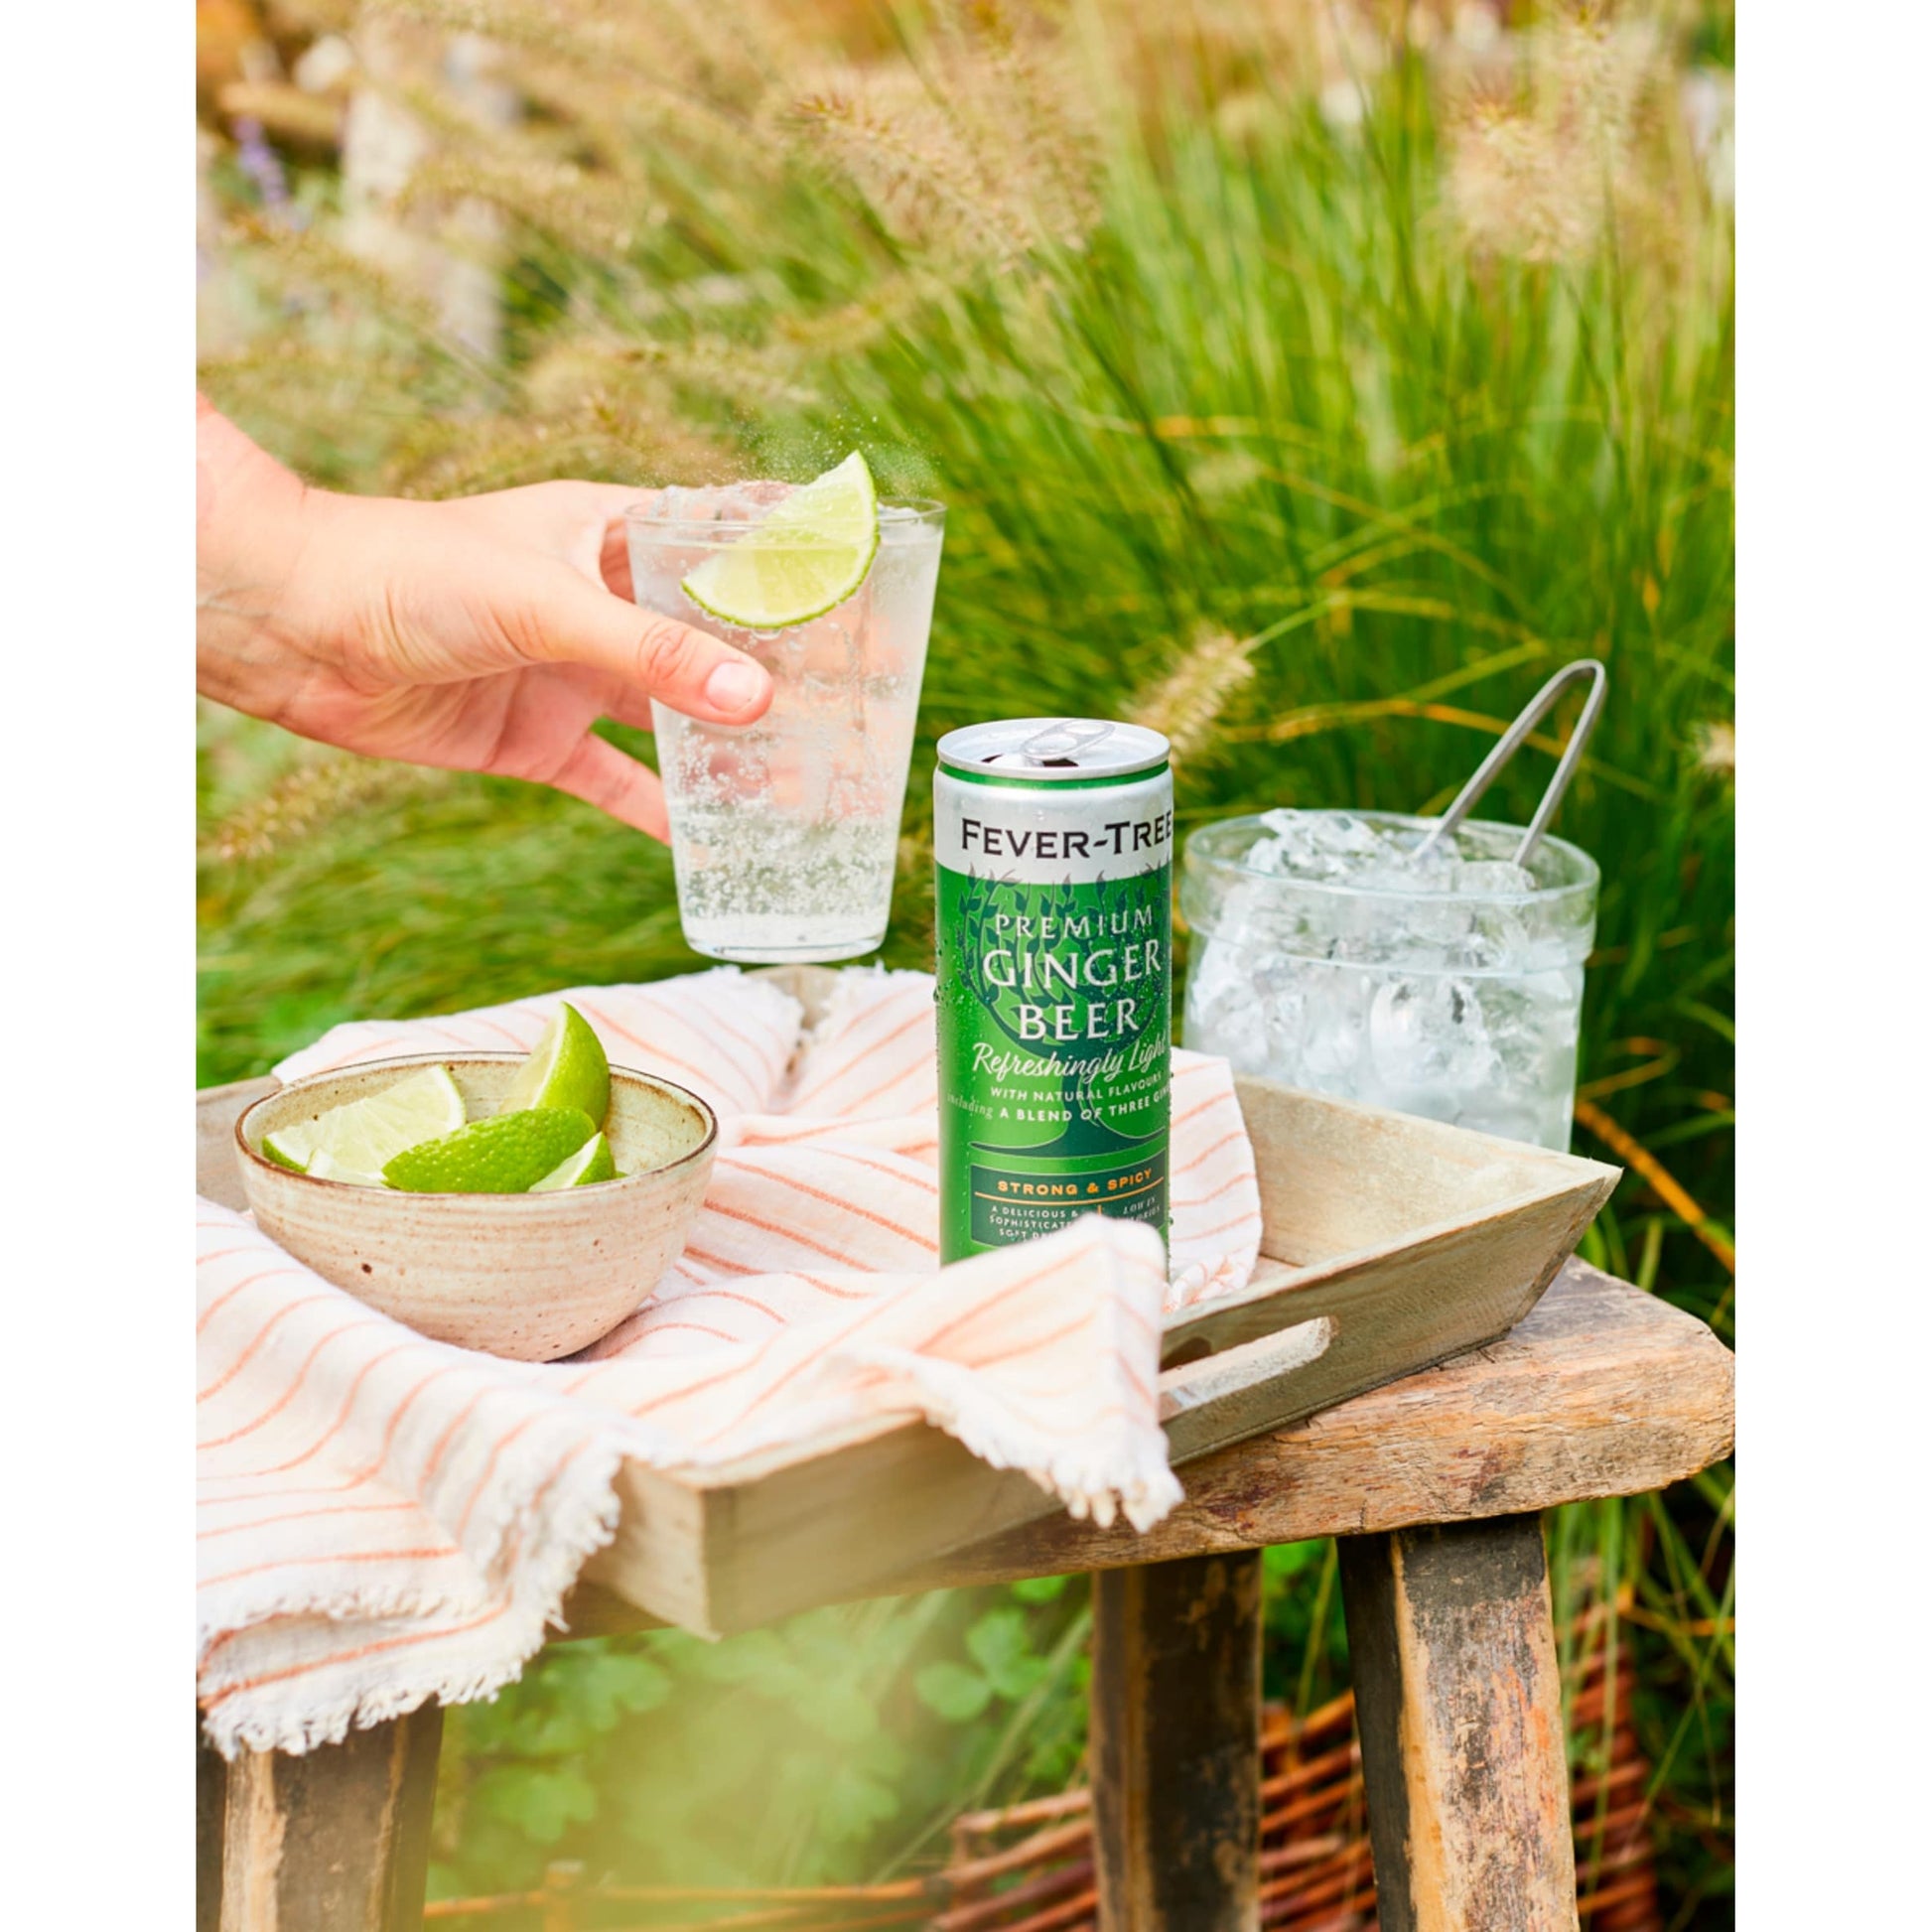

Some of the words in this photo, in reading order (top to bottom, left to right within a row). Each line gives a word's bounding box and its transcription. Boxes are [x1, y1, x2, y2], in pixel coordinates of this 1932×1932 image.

[962, 810, 1172, 860] FEVER-TREE
[995, 904, 1153, 939] PREMIUM
[983, 939, 1162, 989] GINGER
[1019, 998, 1140, 1040] BEER
[972, 1042, 1124, 1084] Refreshingly
[991, 1087, 1028, 1102] WITH
[1033, 1088, 1103, 1102] NATURAL
[1000, 1107, 1009, 1119] A
[1016, 1109, 1073, 1122] BLEND
[1080, 1107, 1103, 1121] OF
[1108, 1095, 1151, 1117] THREE
[998, 1180, 1078, 1195] STRONG
[1086, 1182, 1099, 1193] &
[1107, 1169, 1152, 1191] SPICY
[1002, 1206, 1066, 1218] DELICIOUS
